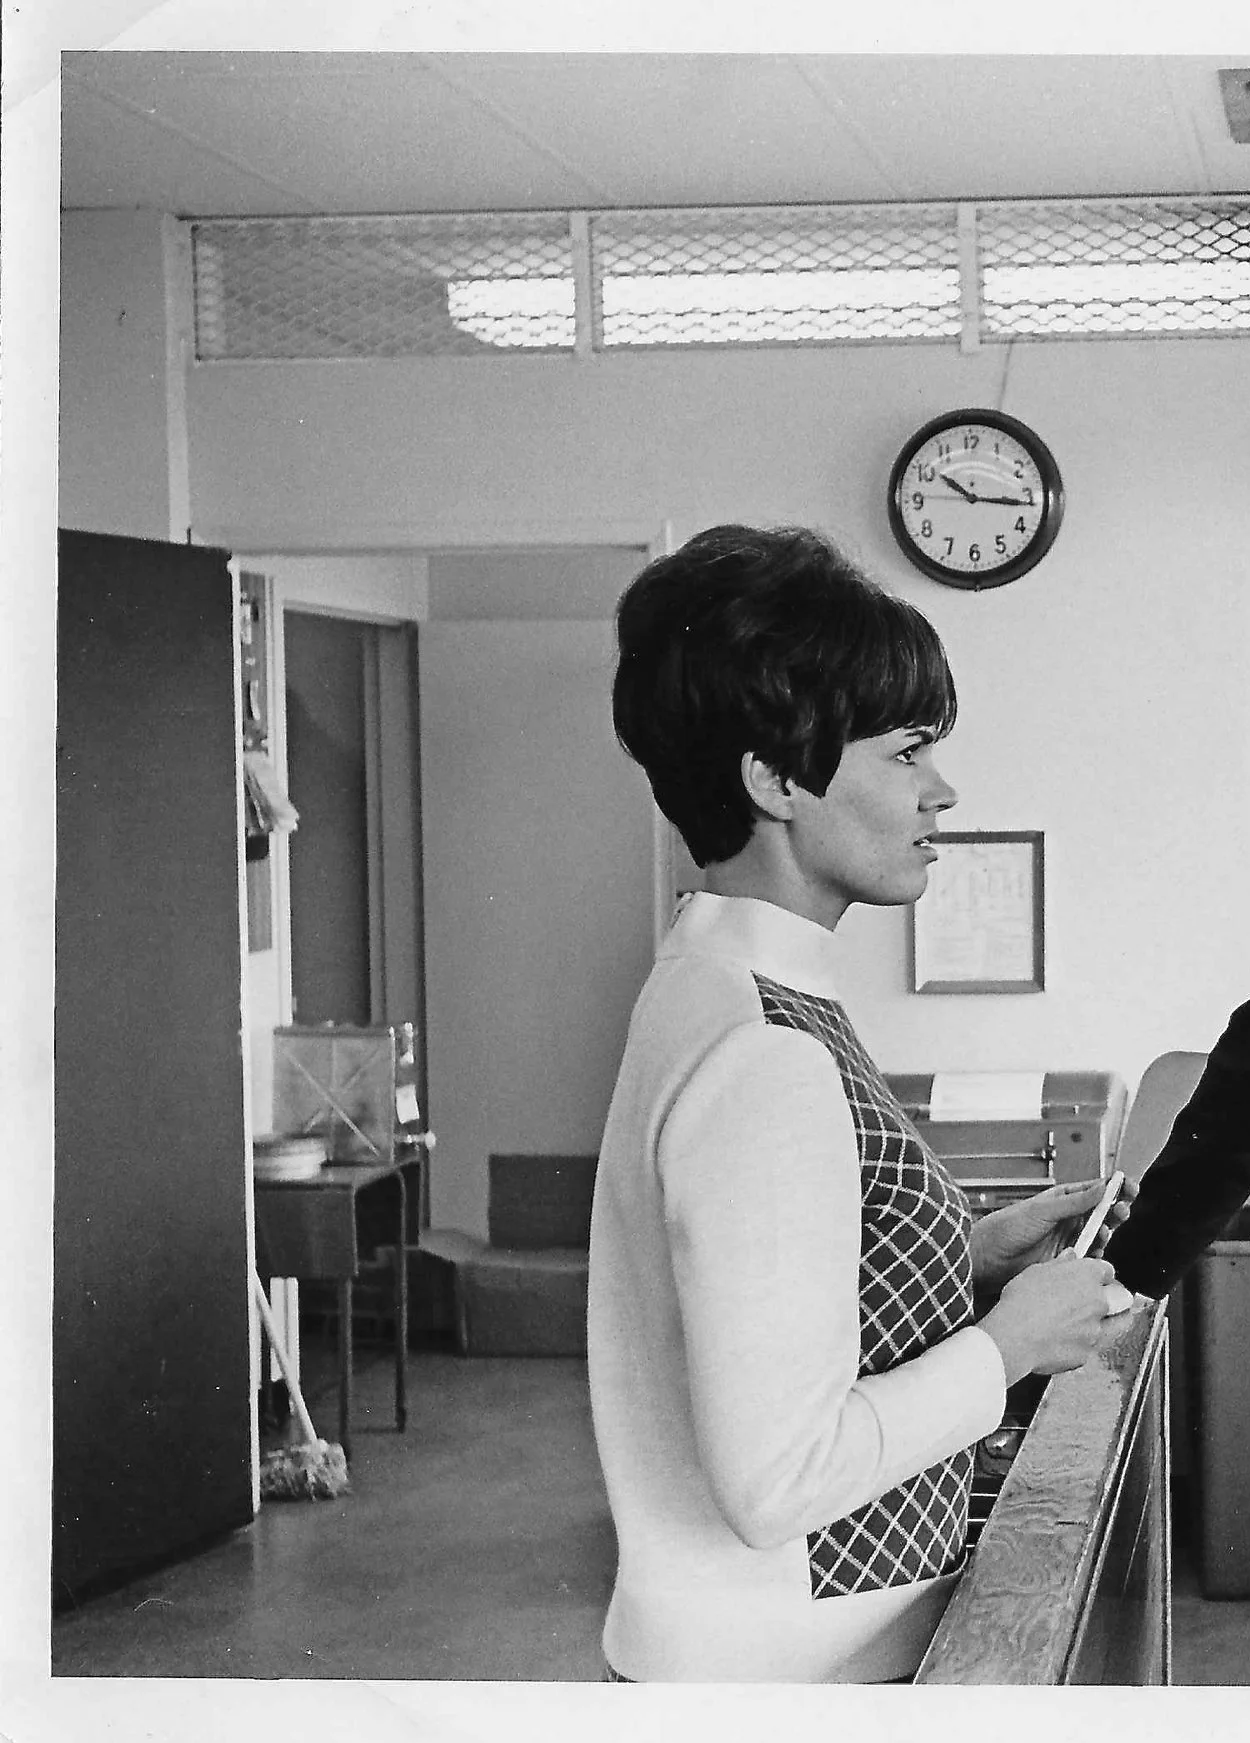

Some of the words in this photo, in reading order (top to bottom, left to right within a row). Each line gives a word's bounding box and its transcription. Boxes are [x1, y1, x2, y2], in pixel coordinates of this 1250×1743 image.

[938, 444, 950, 457] 11
[964, 435, 979, 450] 12
[994, 443, 999, 454] 1
[917, 463, 935, 482] 10
[1013, 460, 1024, 479] 2
[912, 491, 924, 510] 9
[921, 519, 932, 538] 8
[1014, 516, 1026, 533] 4
[944, 537, 954, 555] 7
[969, 543, 981, 562] 6
[995, 534, 1006, 554] 5
